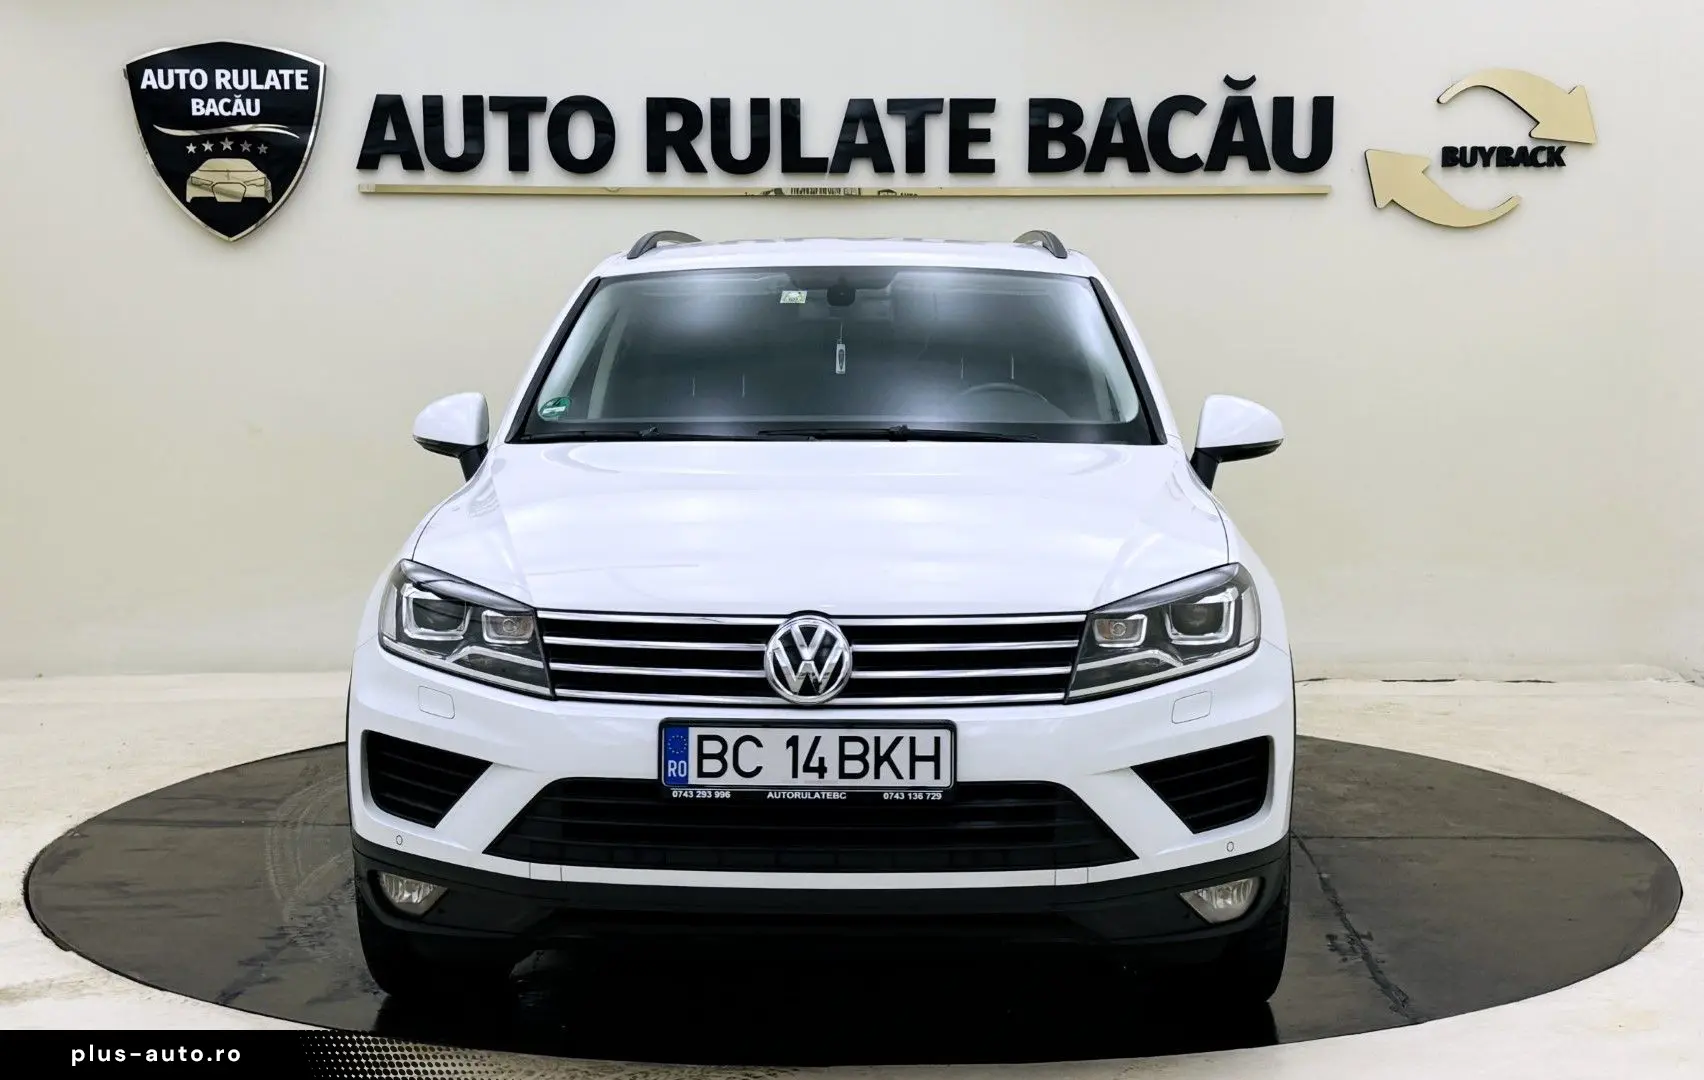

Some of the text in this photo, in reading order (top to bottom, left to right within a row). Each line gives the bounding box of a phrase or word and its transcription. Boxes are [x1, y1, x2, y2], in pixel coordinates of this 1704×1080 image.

[140, 68, 309, 91] AUTO RULATE
[191, 94, 261, 117] BACĂU
[356, 74, 1335, 176] AUTO RULATE BACĂU
[1441, 145, 1567, 168] BUYBACK
[667, 759, 688, 778] RO
[696, 734, 942, 781] BC 14 BKH
[672, 790, 731, 799] 0743 293 996
[767, 791, 847, 800] AUTORULATEBC
[883, 792, 942, 801] 0743 136 729
